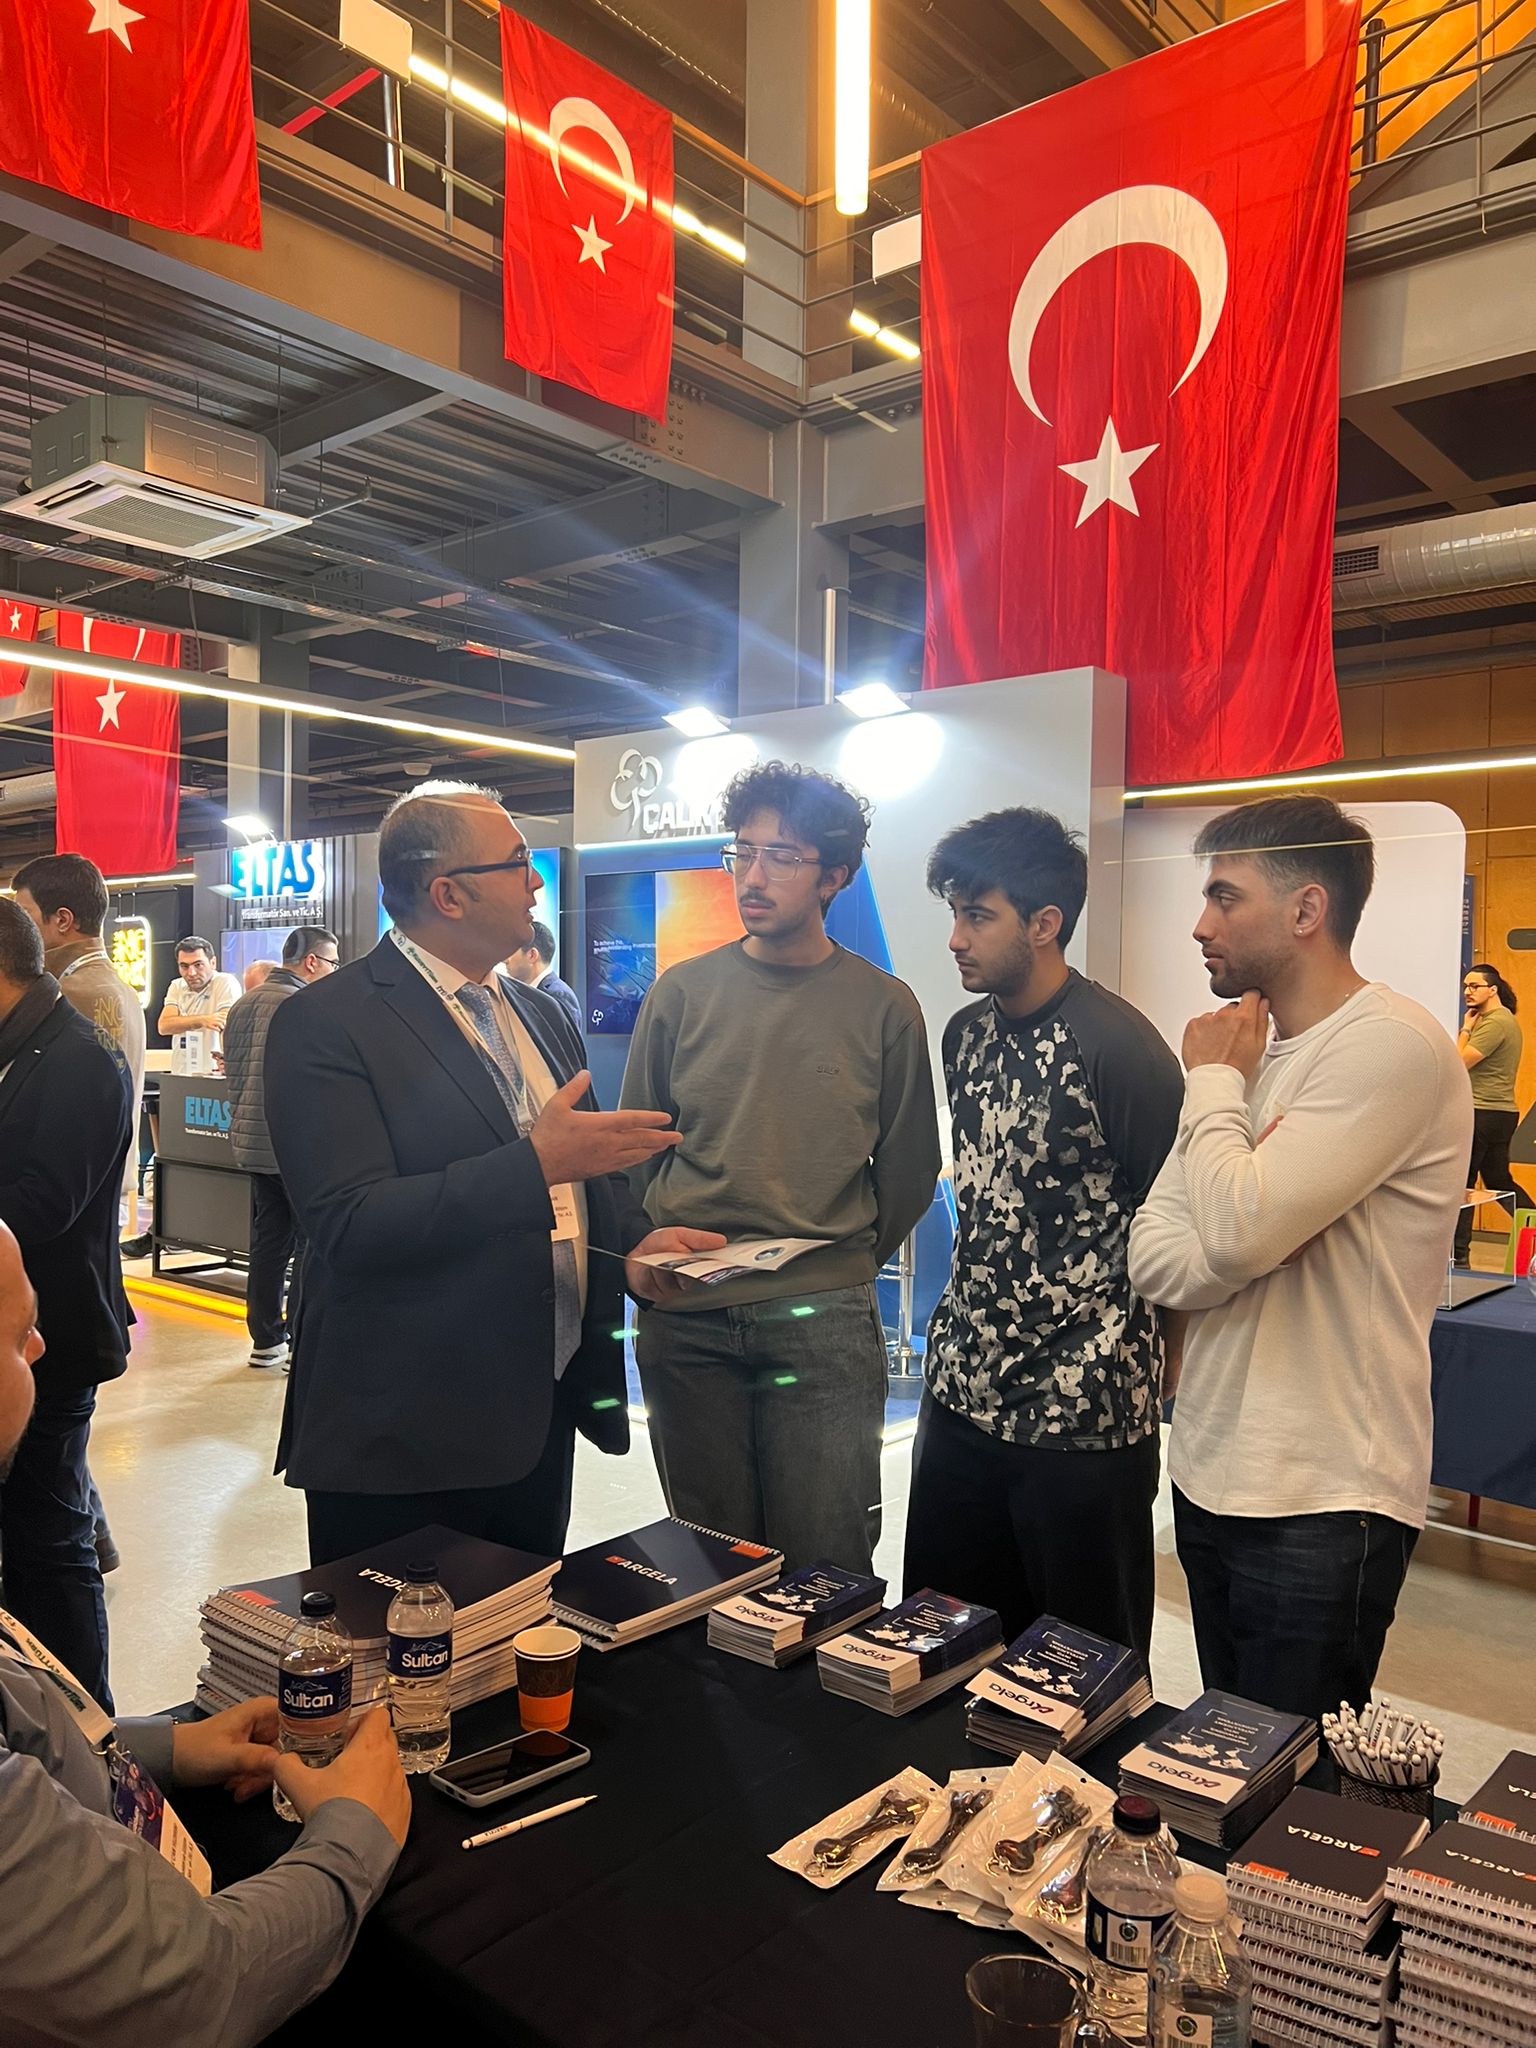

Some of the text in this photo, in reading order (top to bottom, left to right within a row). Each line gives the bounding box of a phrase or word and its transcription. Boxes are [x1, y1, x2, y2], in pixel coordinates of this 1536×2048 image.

[617, 1560, 678, 1585] ARGELA
[401, 1650, 448, 1668] Sultan
[283, 1689, 333, 1708] Sultan
[1287, 1825, 1362, 1852] ARGELA
